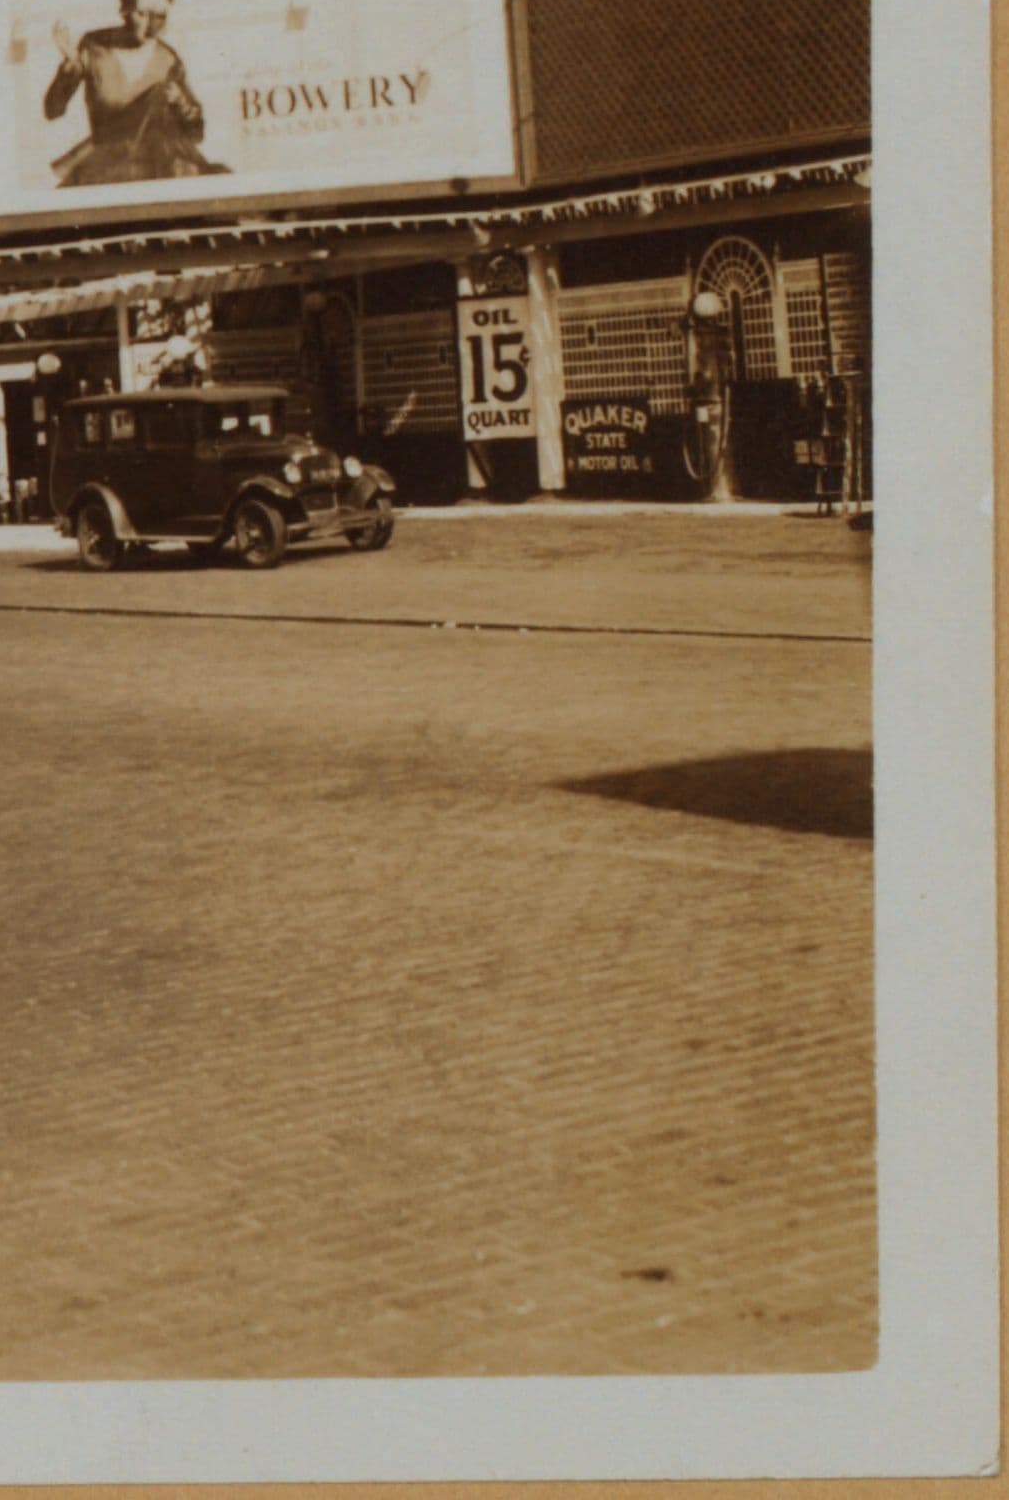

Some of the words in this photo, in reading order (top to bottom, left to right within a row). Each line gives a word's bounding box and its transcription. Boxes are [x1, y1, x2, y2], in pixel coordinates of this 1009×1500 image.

[240, 72, 424, 120] BOWERY
[471, 308, 518, 327] OIL
[466, 407, 531, 435] QUART
[564, 403, 648, 436] QUAKER
[585, 432, 627, 449] STATE
